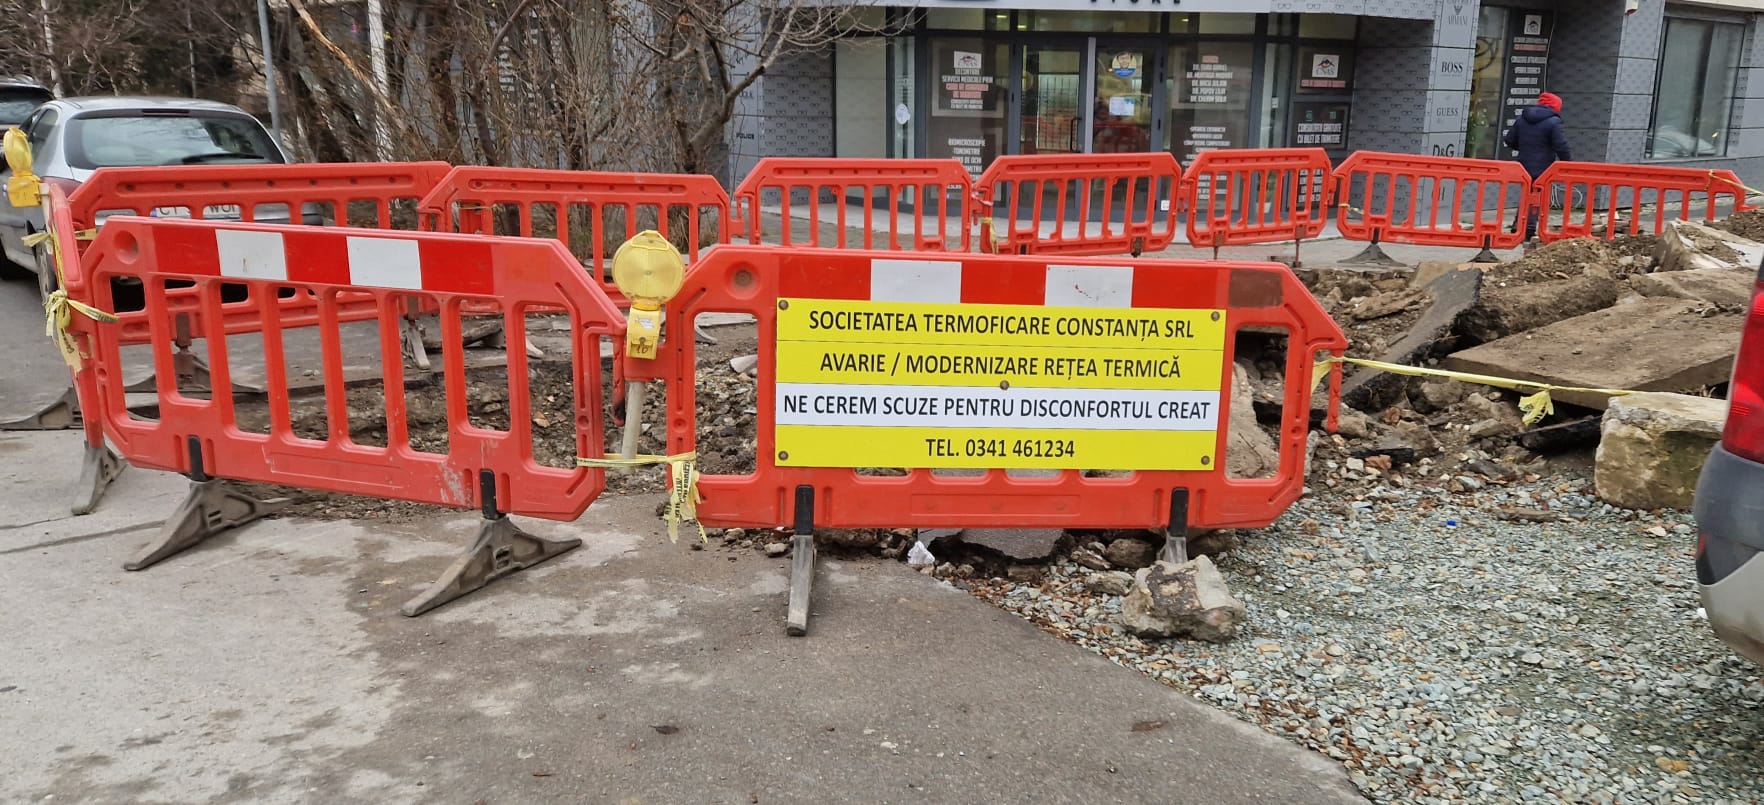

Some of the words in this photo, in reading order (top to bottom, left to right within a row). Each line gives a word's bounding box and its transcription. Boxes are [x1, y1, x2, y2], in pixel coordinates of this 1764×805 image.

[1441, 61, 1463, 73] BOSS
[1436, 107, 1459, 116] GUESS
[1432, 143, 1455, 158] D&G
[809, 310, 918, 332] SOCIETATEA
[923, 313, 1051, 335] TERMOFICARE
[1056, 317, 1160, 342] CONSTANȚA
[1164, 319, 1194, 338] SRL
[820, 353, 886, 373] AVARIE
[890, 352, 901, 376] /
[906, 354, 1038, 376] MODERNIZARE
[1044, 357, 1098, 380] REȚEA
[1103, 355, 1181, 378] TERMICĂ
[784, 395, 808, 413] NE
[814, 395, 877, 414] CEREM
[882, 397, 938, 415] SCUZE
[944, 398, 1014, 416] PENTRU
[1020, 399, 1153, 419] DISCONFORTUL
[1158, 401, 1210, 419] CREAT
[925, 438, 960, 457] TEL.
[965, 439, 1007, 457] 0341
[1012, 439, 1075, 458] 461234
